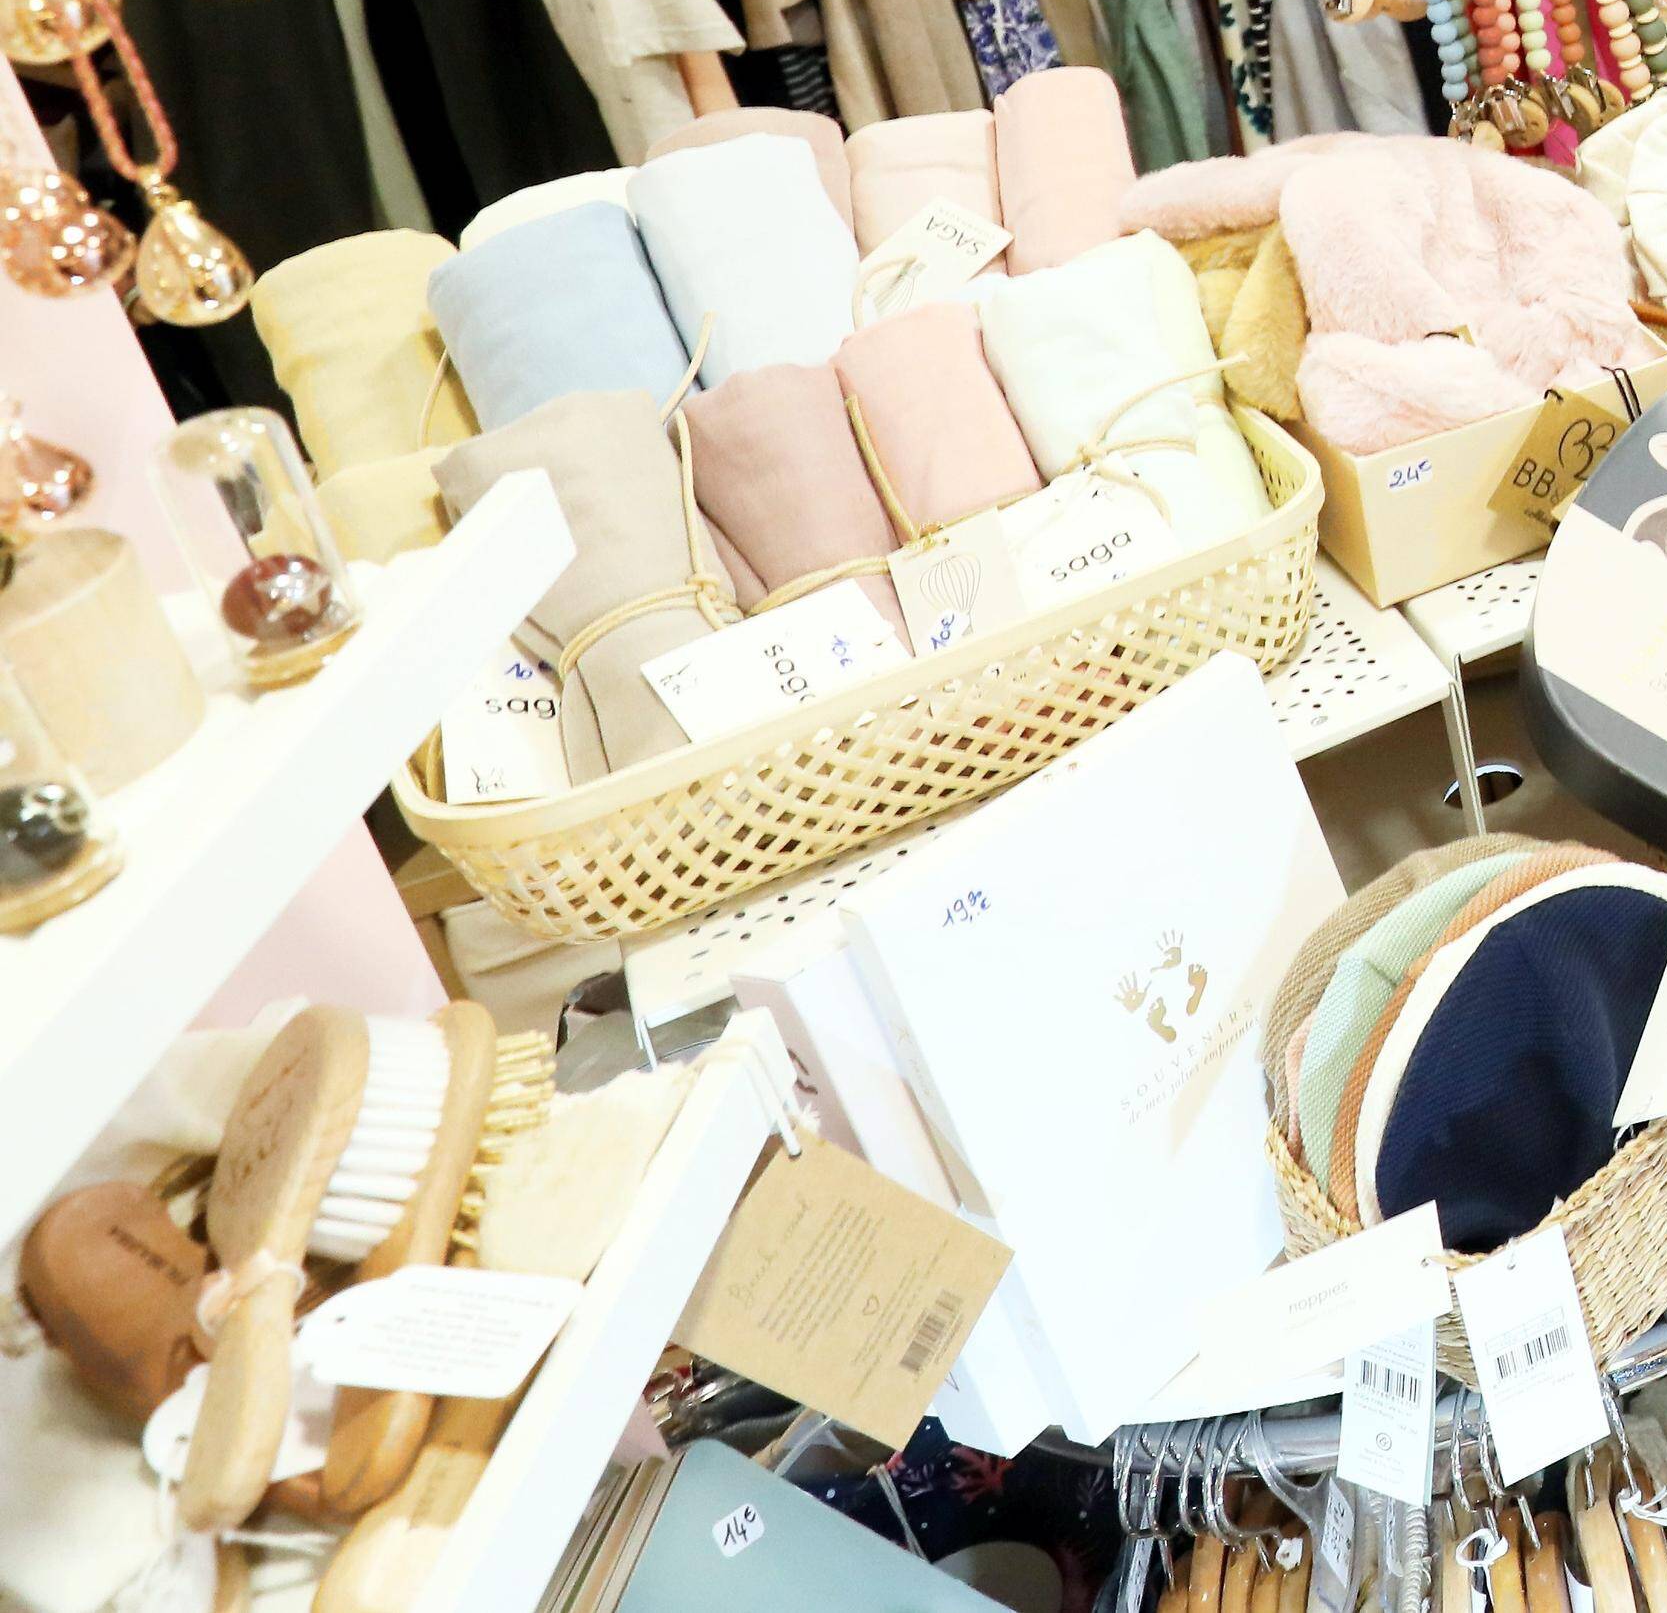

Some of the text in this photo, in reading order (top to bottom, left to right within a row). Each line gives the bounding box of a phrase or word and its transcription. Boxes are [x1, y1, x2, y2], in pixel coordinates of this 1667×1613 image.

[925, 215, 987, 257] SAGA
[1050, 531, 1133, 582] saga
[485, 696, 562, 720] sag
[1120, 998, 1254, 1111] SOUVENIRS
[1288, 1280, 1350, 1317] noppies
[722, 1506, 757, 1547] 14€
